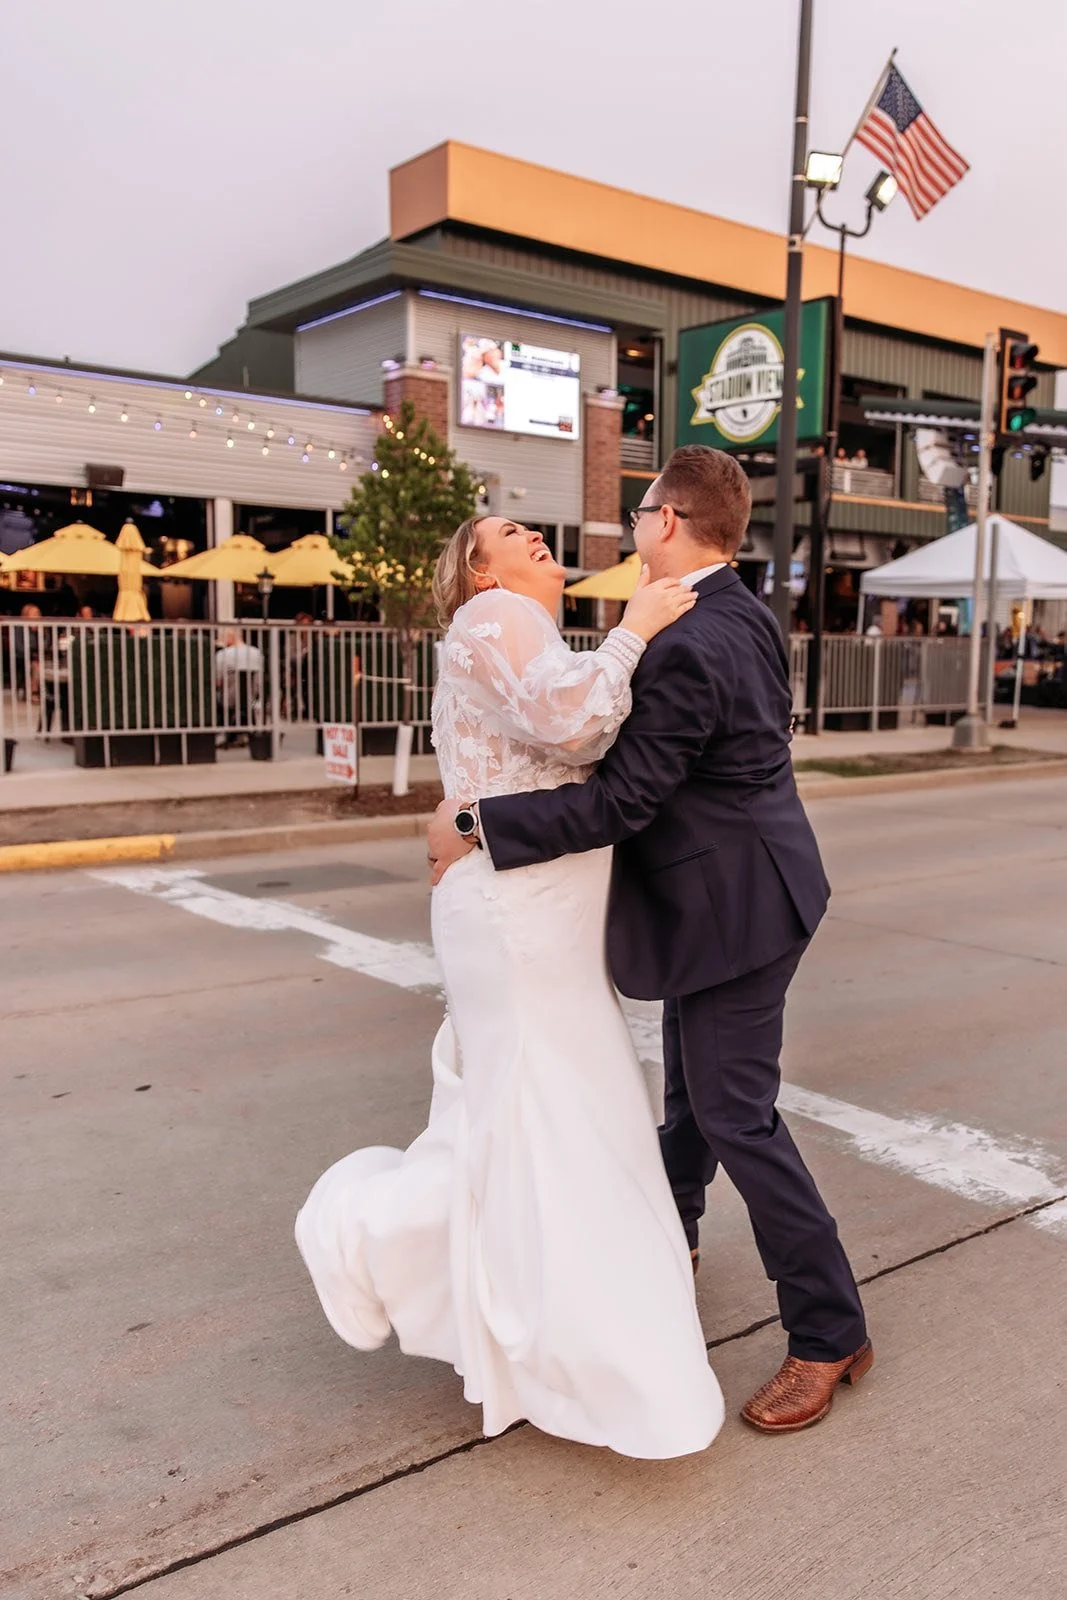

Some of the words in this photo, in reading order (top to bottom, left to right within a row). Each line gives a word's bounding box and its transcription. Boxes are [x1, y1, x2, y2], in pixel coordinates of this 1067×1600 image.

[709, 371, 752, 402] STADIUM
[326, 727, 339, 739] HOT
[341, 727, 353, 743] TUB
[331, 743, 348, 759] SALE
